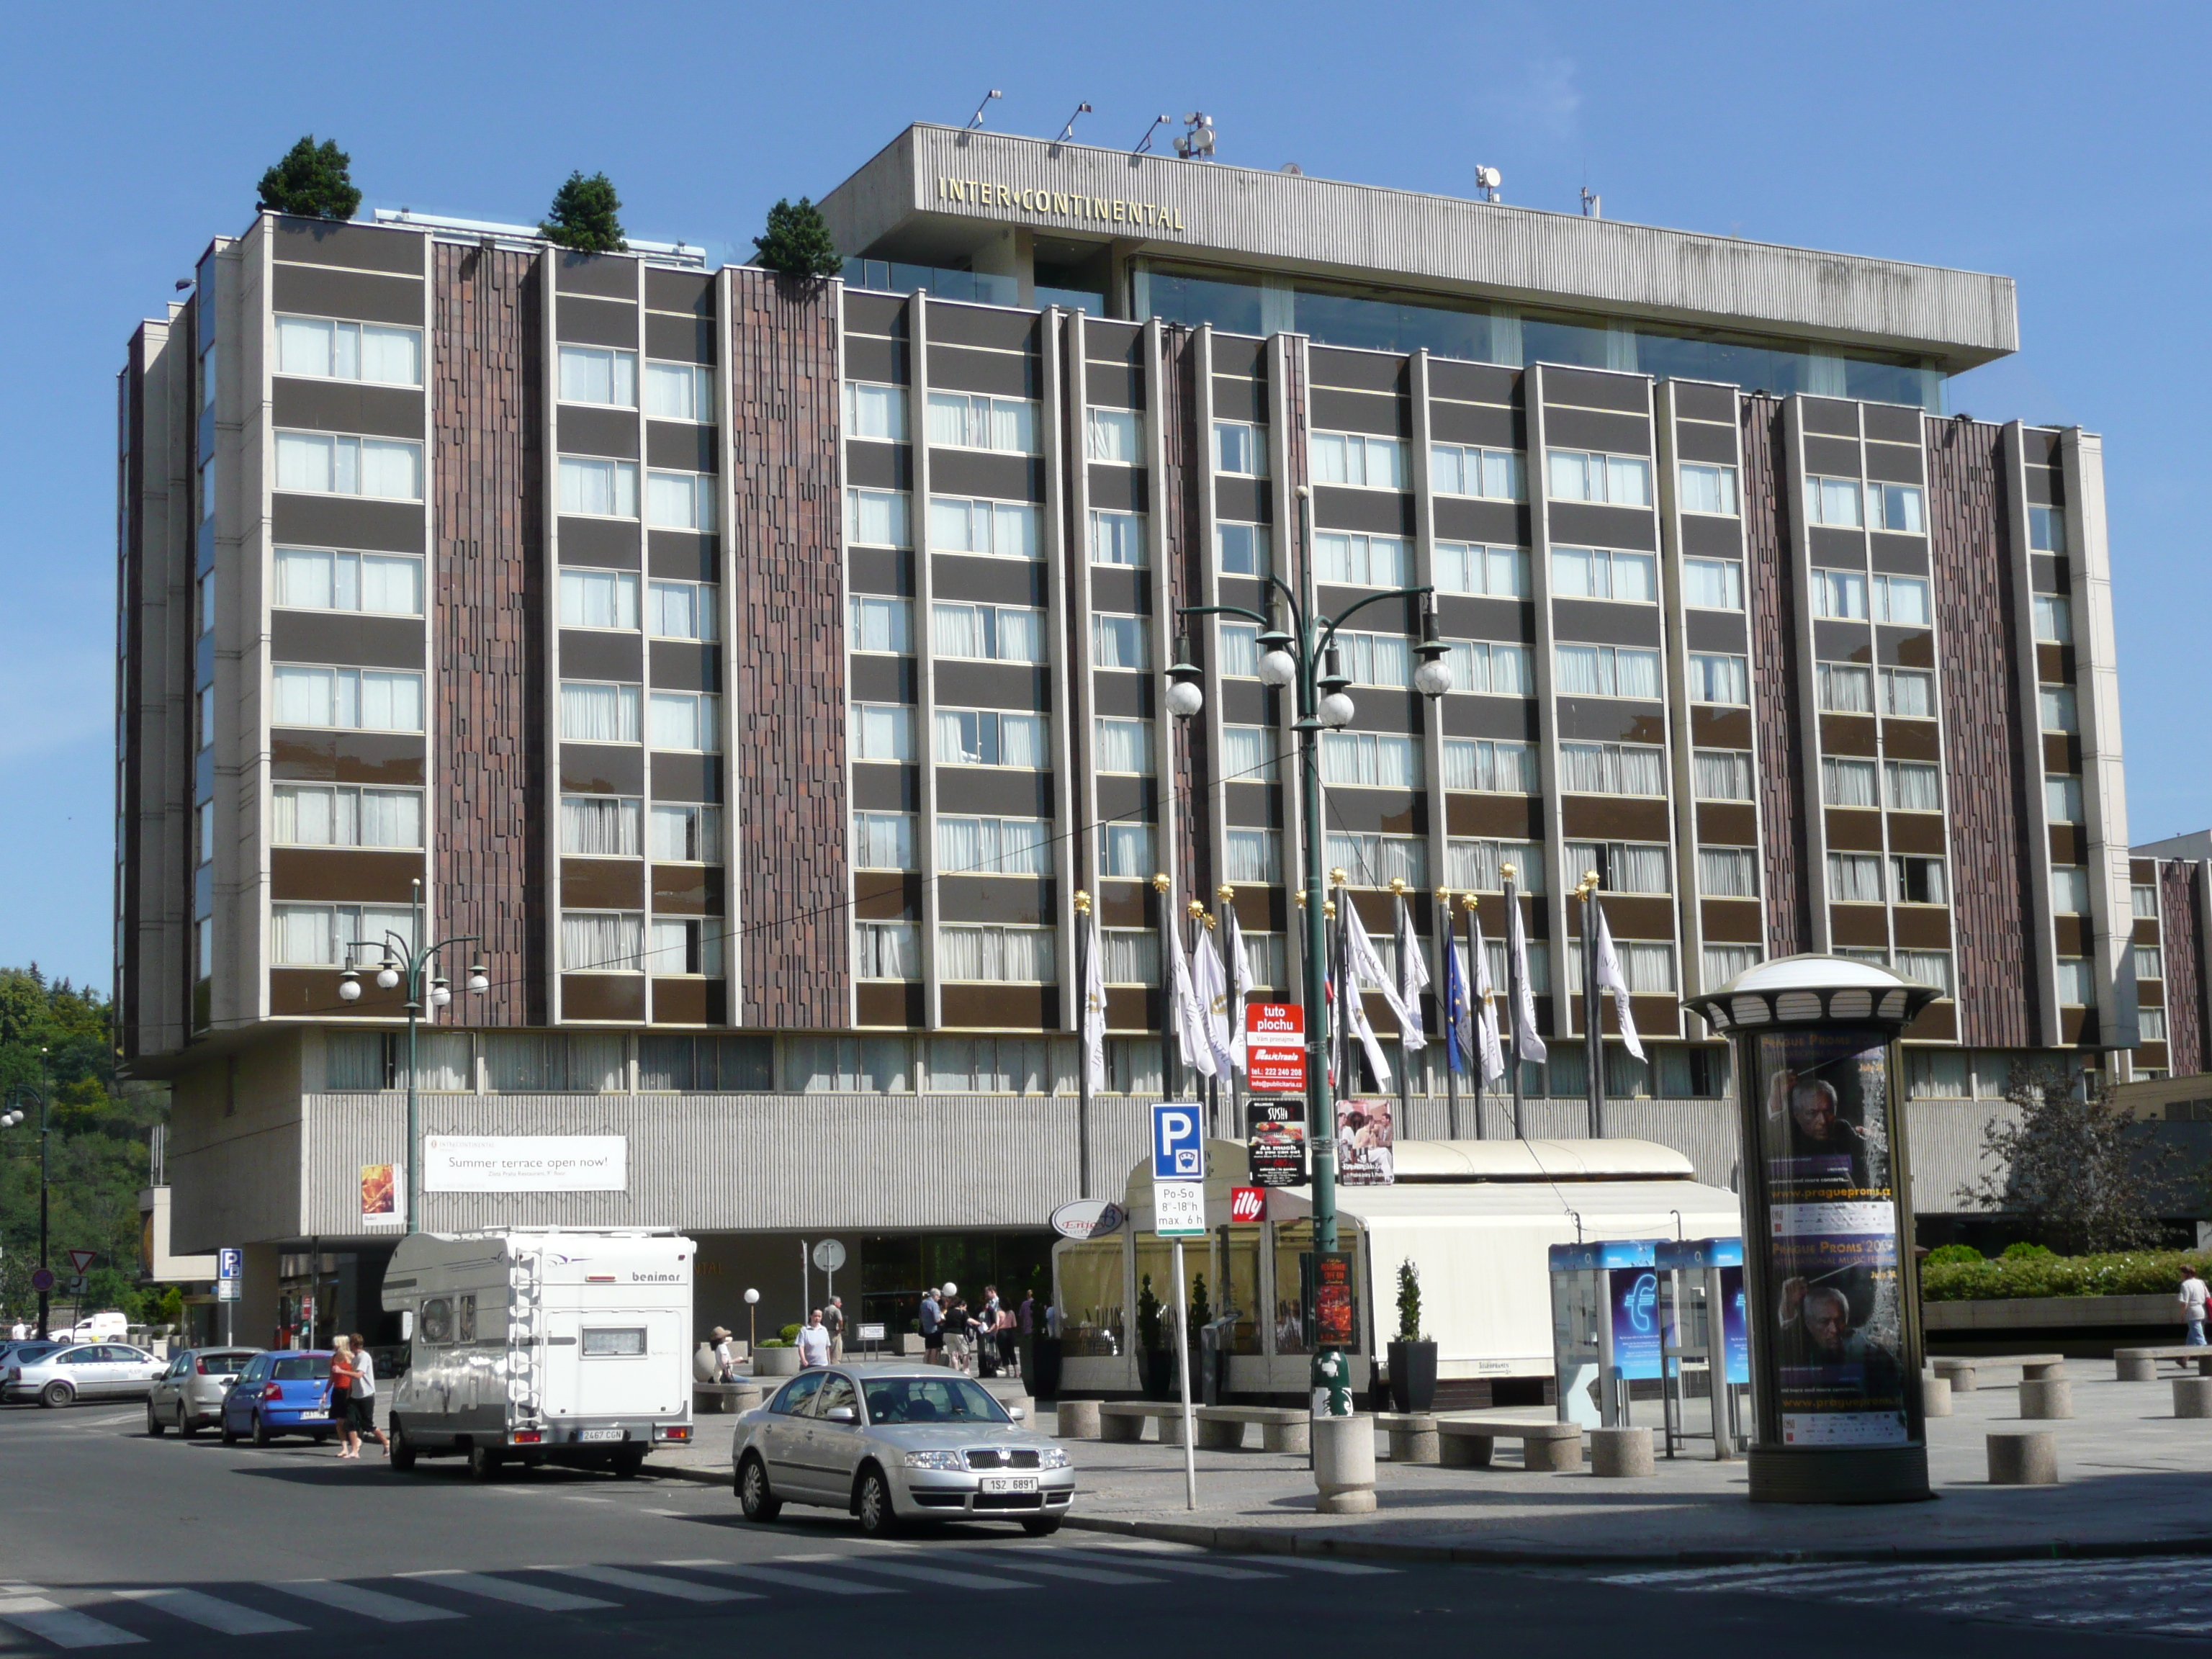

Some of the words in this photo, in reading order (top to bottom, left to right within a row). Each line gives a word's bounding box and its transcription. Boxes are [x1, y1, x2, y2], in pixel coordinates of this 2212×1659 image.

[1264, 1005, 1285, 1017] tuto
[1257, 1018, 1293, 1032] plochu
[1268, 1107, 1288, 1120] SUSHI
[1161, 1112, 1192, 1156] P
[449, 1156, 498, 1167] Summer
[547, 1159, 575, 1169] open
[580, 1156, 608, 1167] now!
[1164, 1188, 1195, 1198] Po-So
[1771, 1187, 1892, 1200] www.pragueproms.cz
[1233, 1191, 1262, 1220] illy
[1187, 1215, 1193, 1225] 6
[1197, 1215, 1202, 1224] h
[1820, 1241, 1863, 1254] PROMS
[225, 1252, 238, 1270] P
[1839, 1256, 1866, 1264] MUSIC
[632, 1271, 680, 1282] benimar
[584, 1431, 604, 1439] 2467
[606, 1430, 621, 1439] CGN
[990, 1480, 1007, 1490] 1S2
[1012, 1479, 1034, 1490] 6891
